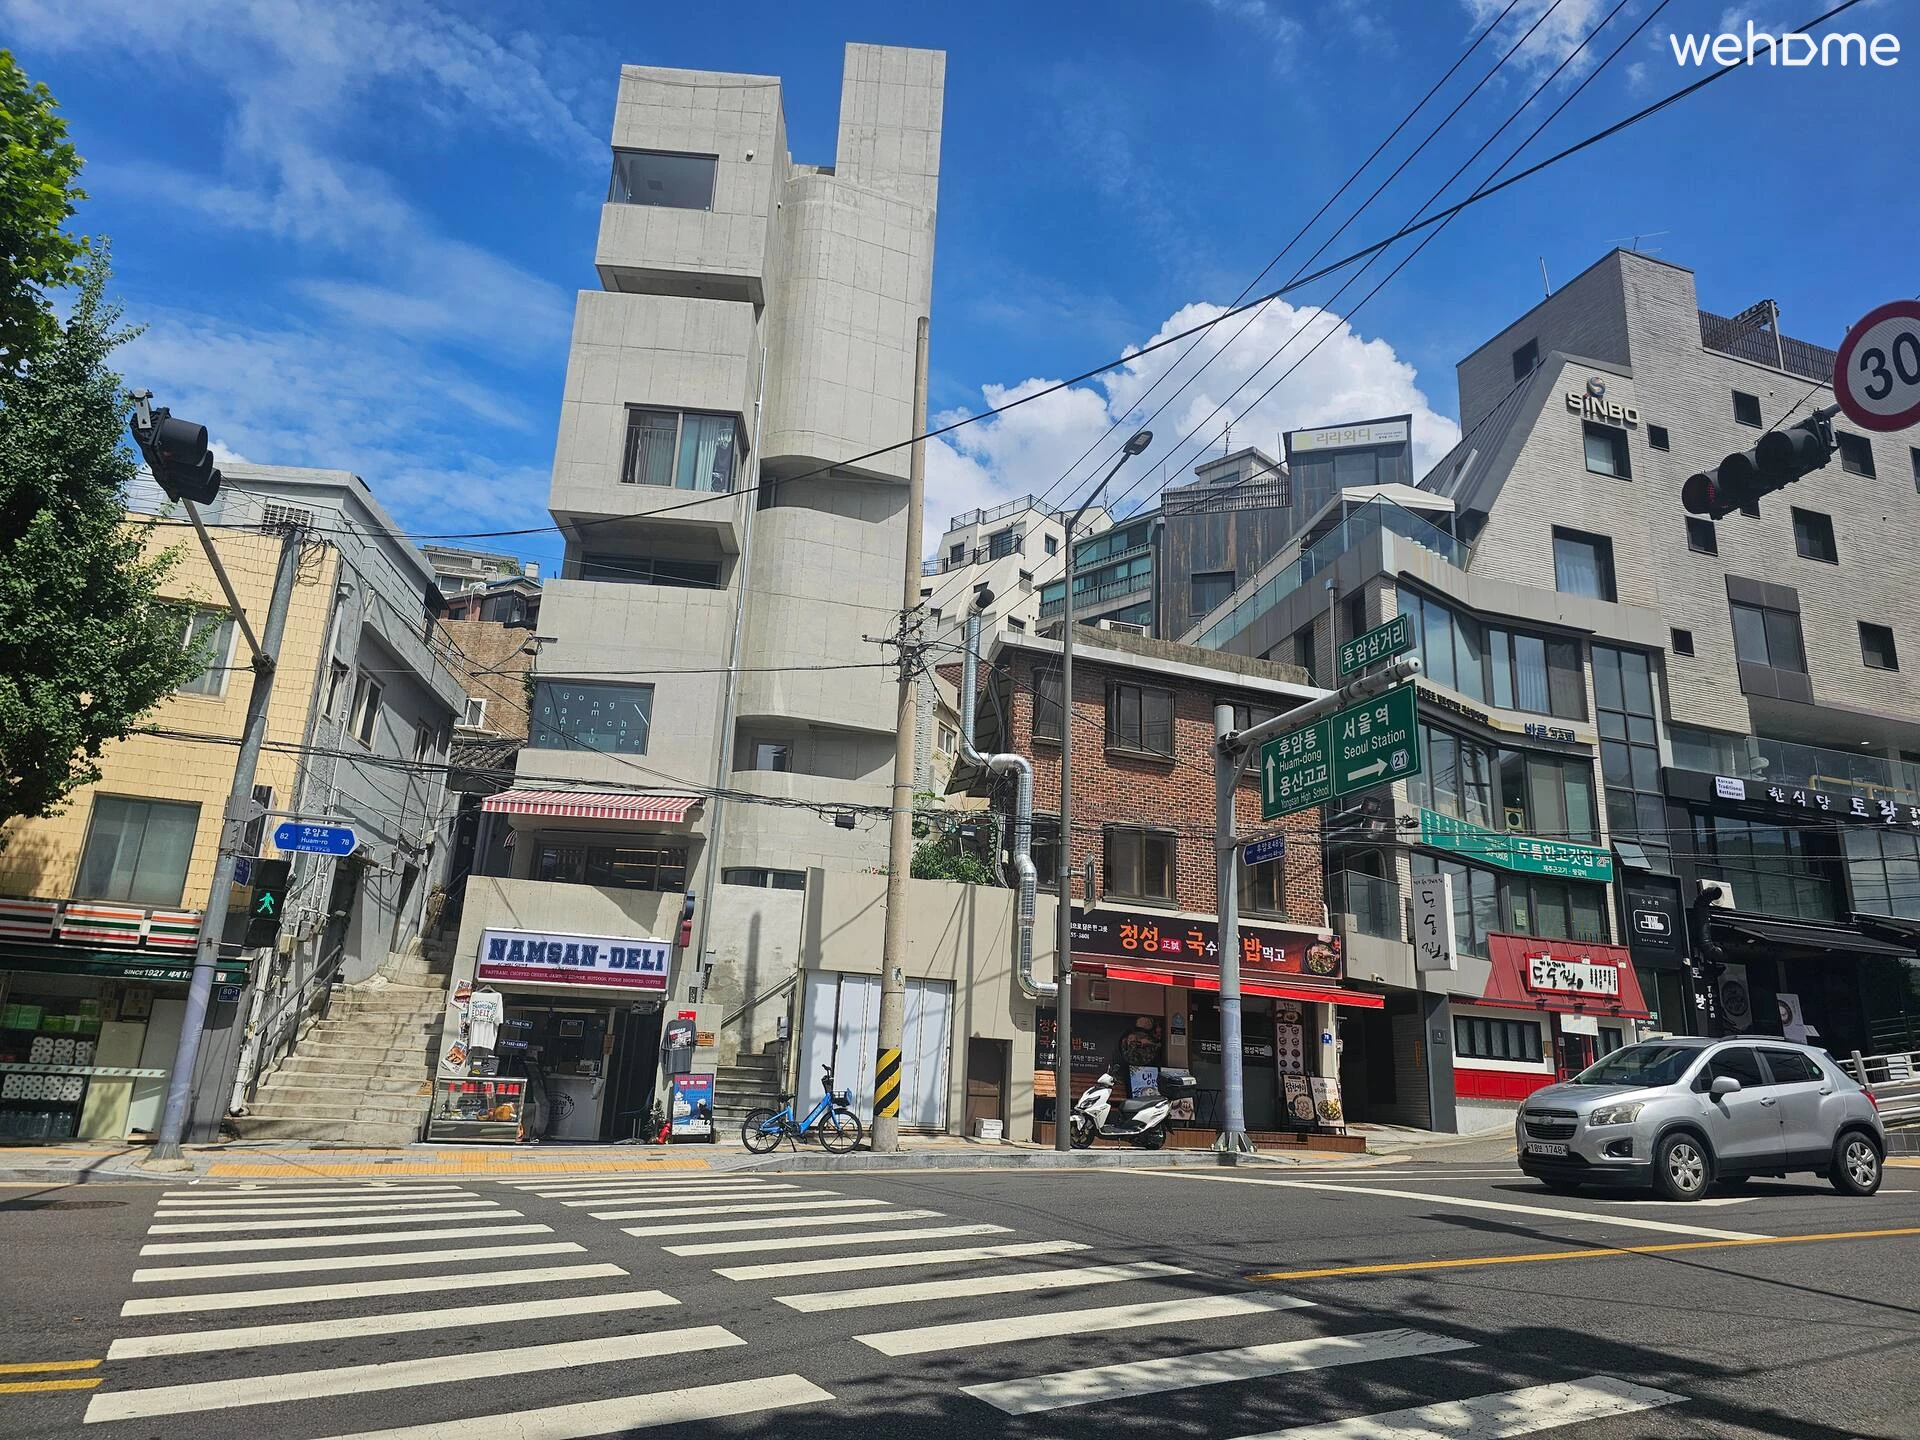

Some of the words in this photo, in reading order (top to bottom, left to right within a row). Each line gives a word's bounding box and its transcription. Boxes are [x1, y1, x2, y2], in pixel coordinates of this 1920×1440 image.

[1860, 332, 1920, 401] 30
[1567, 391, 1640, 423] SINBO
[1343, 625, 1405, 668] 후암삼거리
[1278, 728, 1317, 759] 후암동
[1344, 742, 1369, 760] Seoul
[1371, 729, 1406, 750] Station
[1279, 749, 1322, 772] Huam-dong
[1394, 753, 1407, 767] 21
[1279, 763, 1328, 797] 용산고교
[1301, 791, 1312, 804] High
[1313, 784, 1330, 799] School
[1768, 787, 1831, 811] 한식당
[1850, 797, 1899, 825] 토란
[279, 832, 289, 840] 82
[300, 836, 329, 846] Huam-ro
[302, 827, 329, 838] 후암로
[341, 838, 350, 846] 78
[1119, 924, 1159, 952] 정성
[488, 937, 666, 972] NAMSAN-DELI
[123, 968, 144, 976] SINCE
[144, 969, 165, 977] 1927
